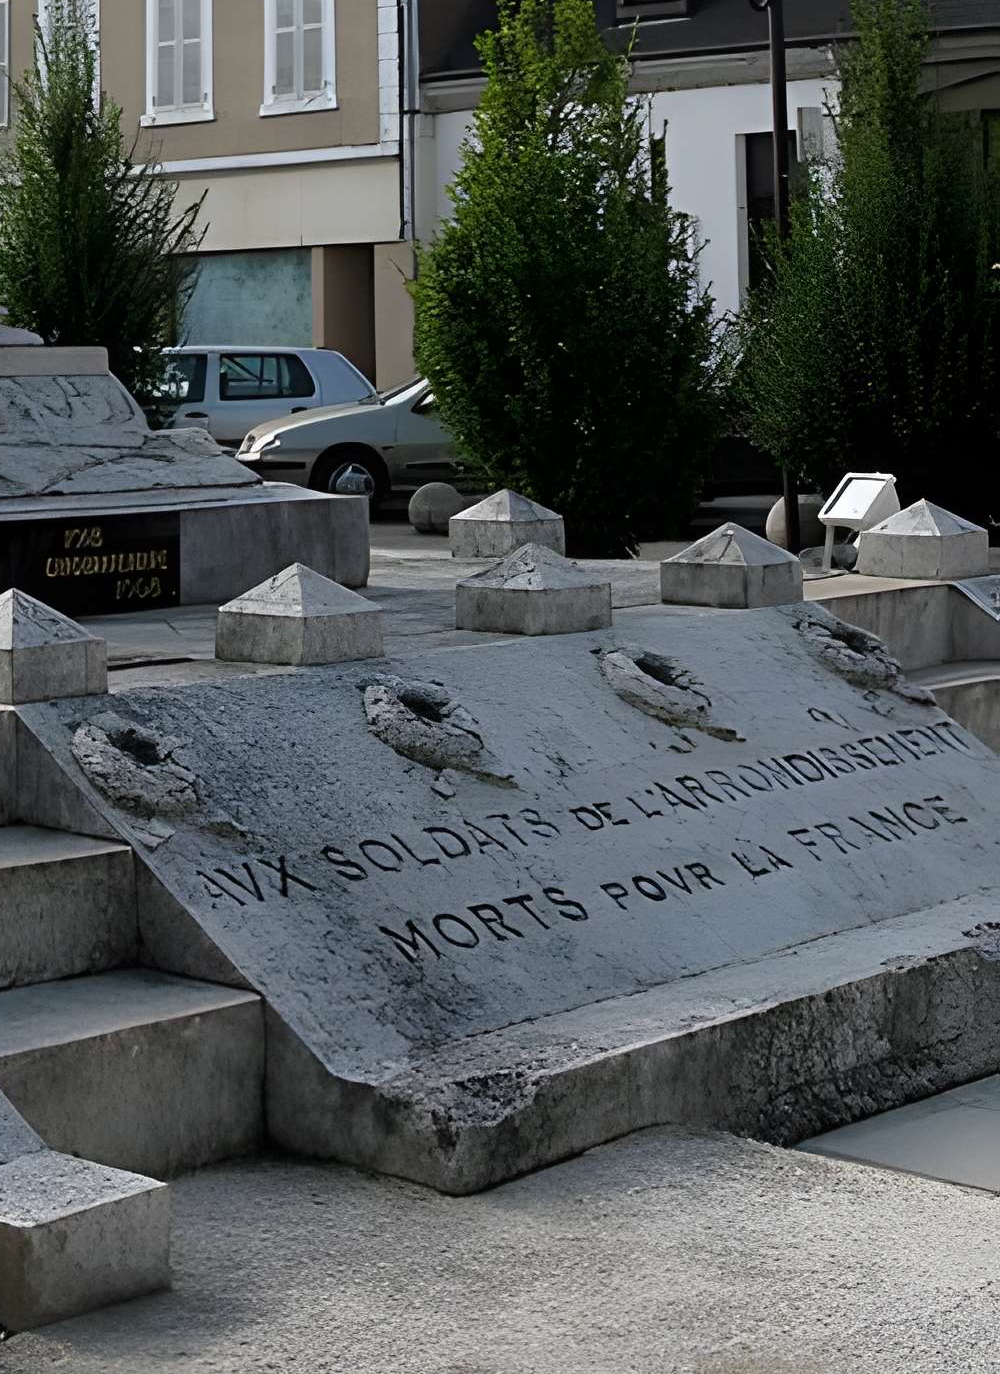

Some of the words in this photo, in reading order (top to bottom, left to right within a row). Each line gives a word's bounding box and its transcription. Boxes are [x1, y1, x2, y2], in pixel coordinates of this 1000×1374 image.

[320, 808, 561, 882] SOLDATS
[568, 801, 631, 832] DE
[378, 887, 589, 964] MORTS
[600, 861, 727, 911] POVR
[730, 844, 794, 879] LA
[787, 794, 970, 862] FRANCE
